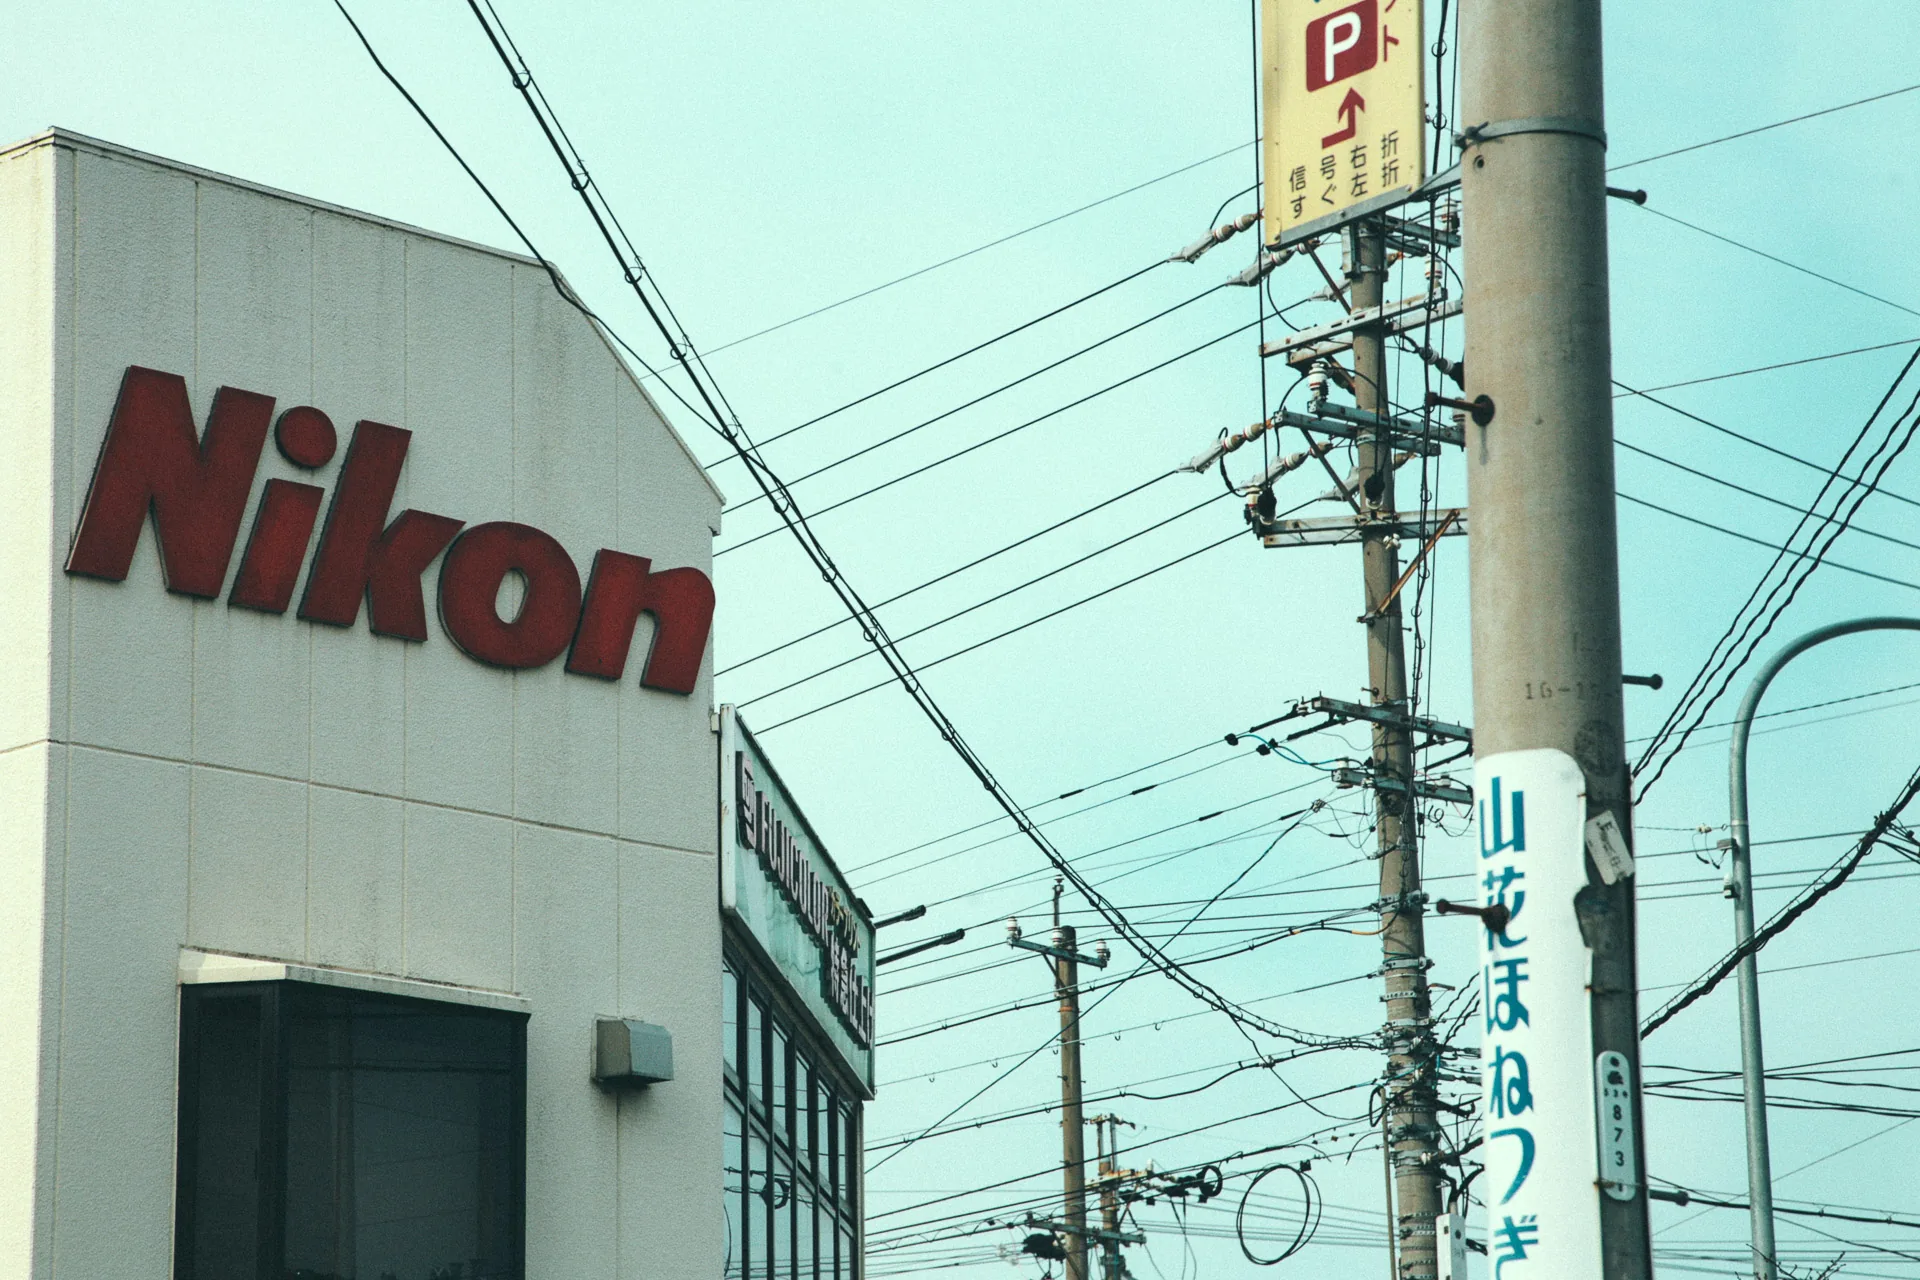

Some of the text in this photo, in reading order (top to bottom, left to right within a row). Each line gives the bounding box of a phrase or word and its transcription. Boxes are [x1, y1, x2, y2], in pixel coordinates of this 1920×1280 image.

[1325, 11, 1361, 82] P
[64, 364, 716, 694] Nikon
[761, 789, 830, 949] FUJICOLOR
[1612, 1104, 1625, 1167] 873
